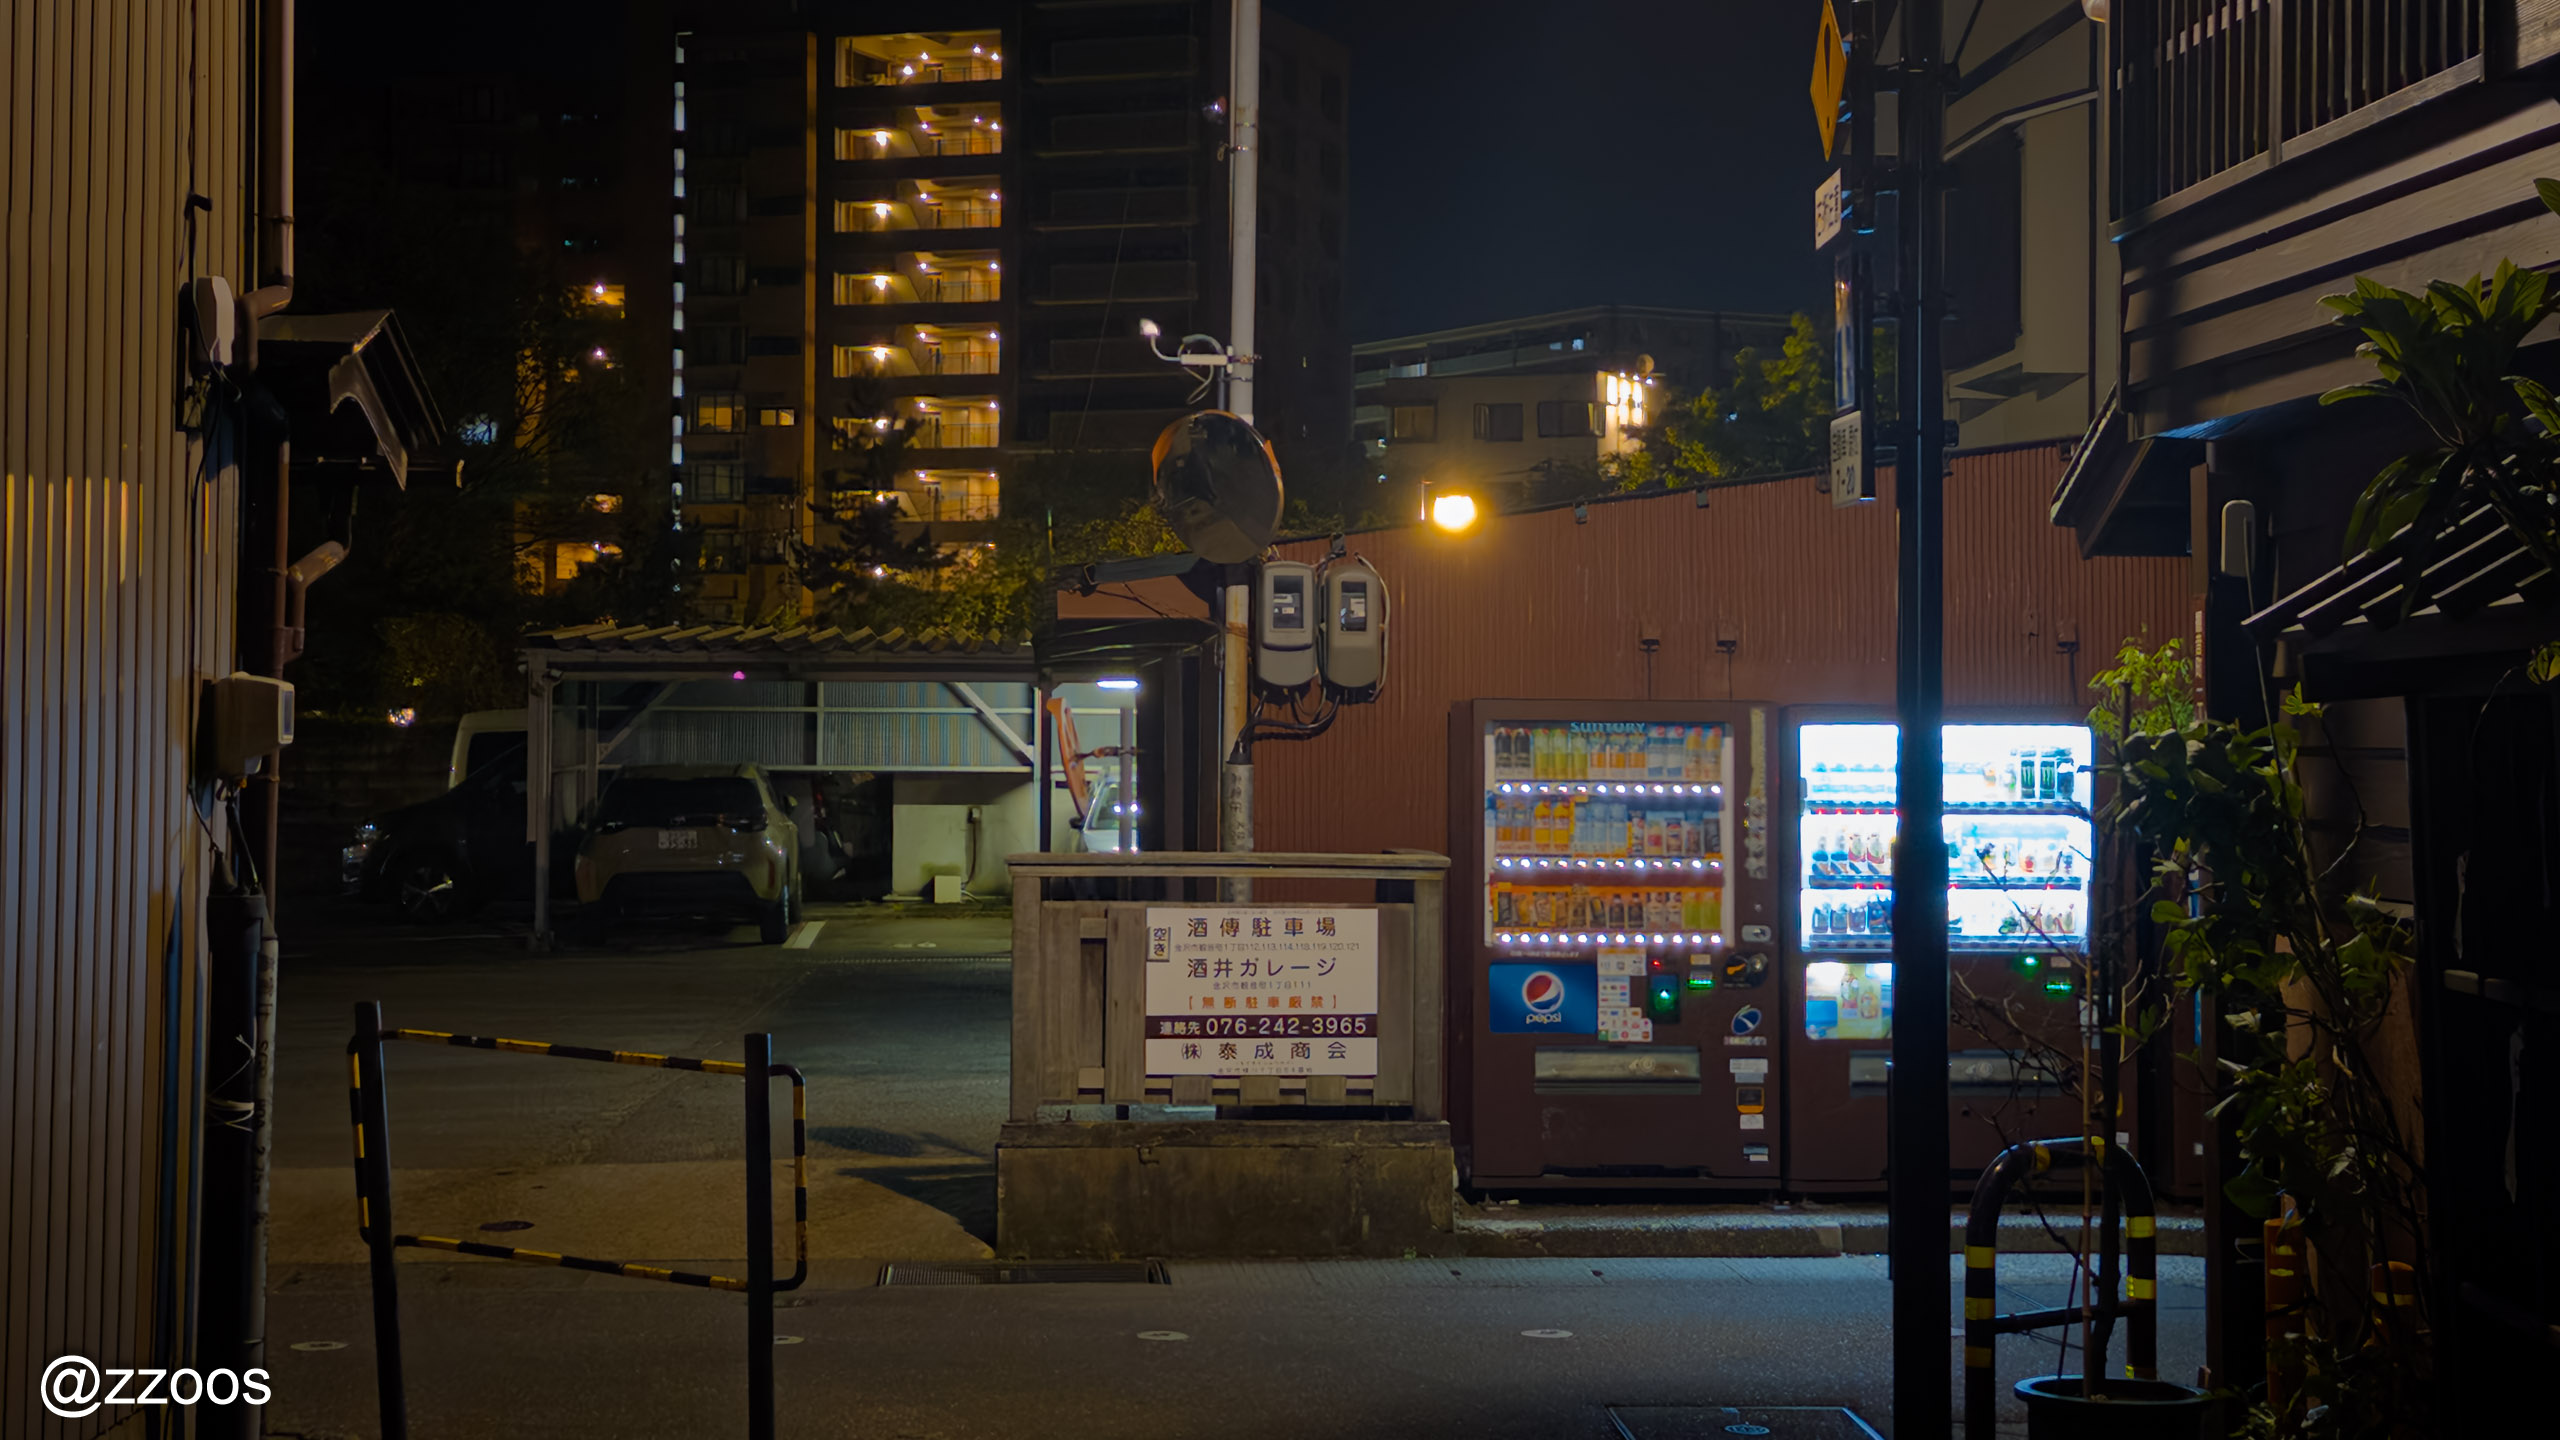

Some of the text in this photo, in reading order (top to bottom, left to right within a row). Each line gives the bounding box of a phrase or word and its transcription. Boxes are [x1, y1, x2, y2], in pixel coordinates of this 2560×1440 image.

[1570, 721, 1645, 734] SUNTORY
[1187, 957, 1337, 979] 酒井ガレージ
[1526, 1012, 1562, 1024] pepsi
[1159, 1017, 1367, 1036] 連絡先 076-242-3965
